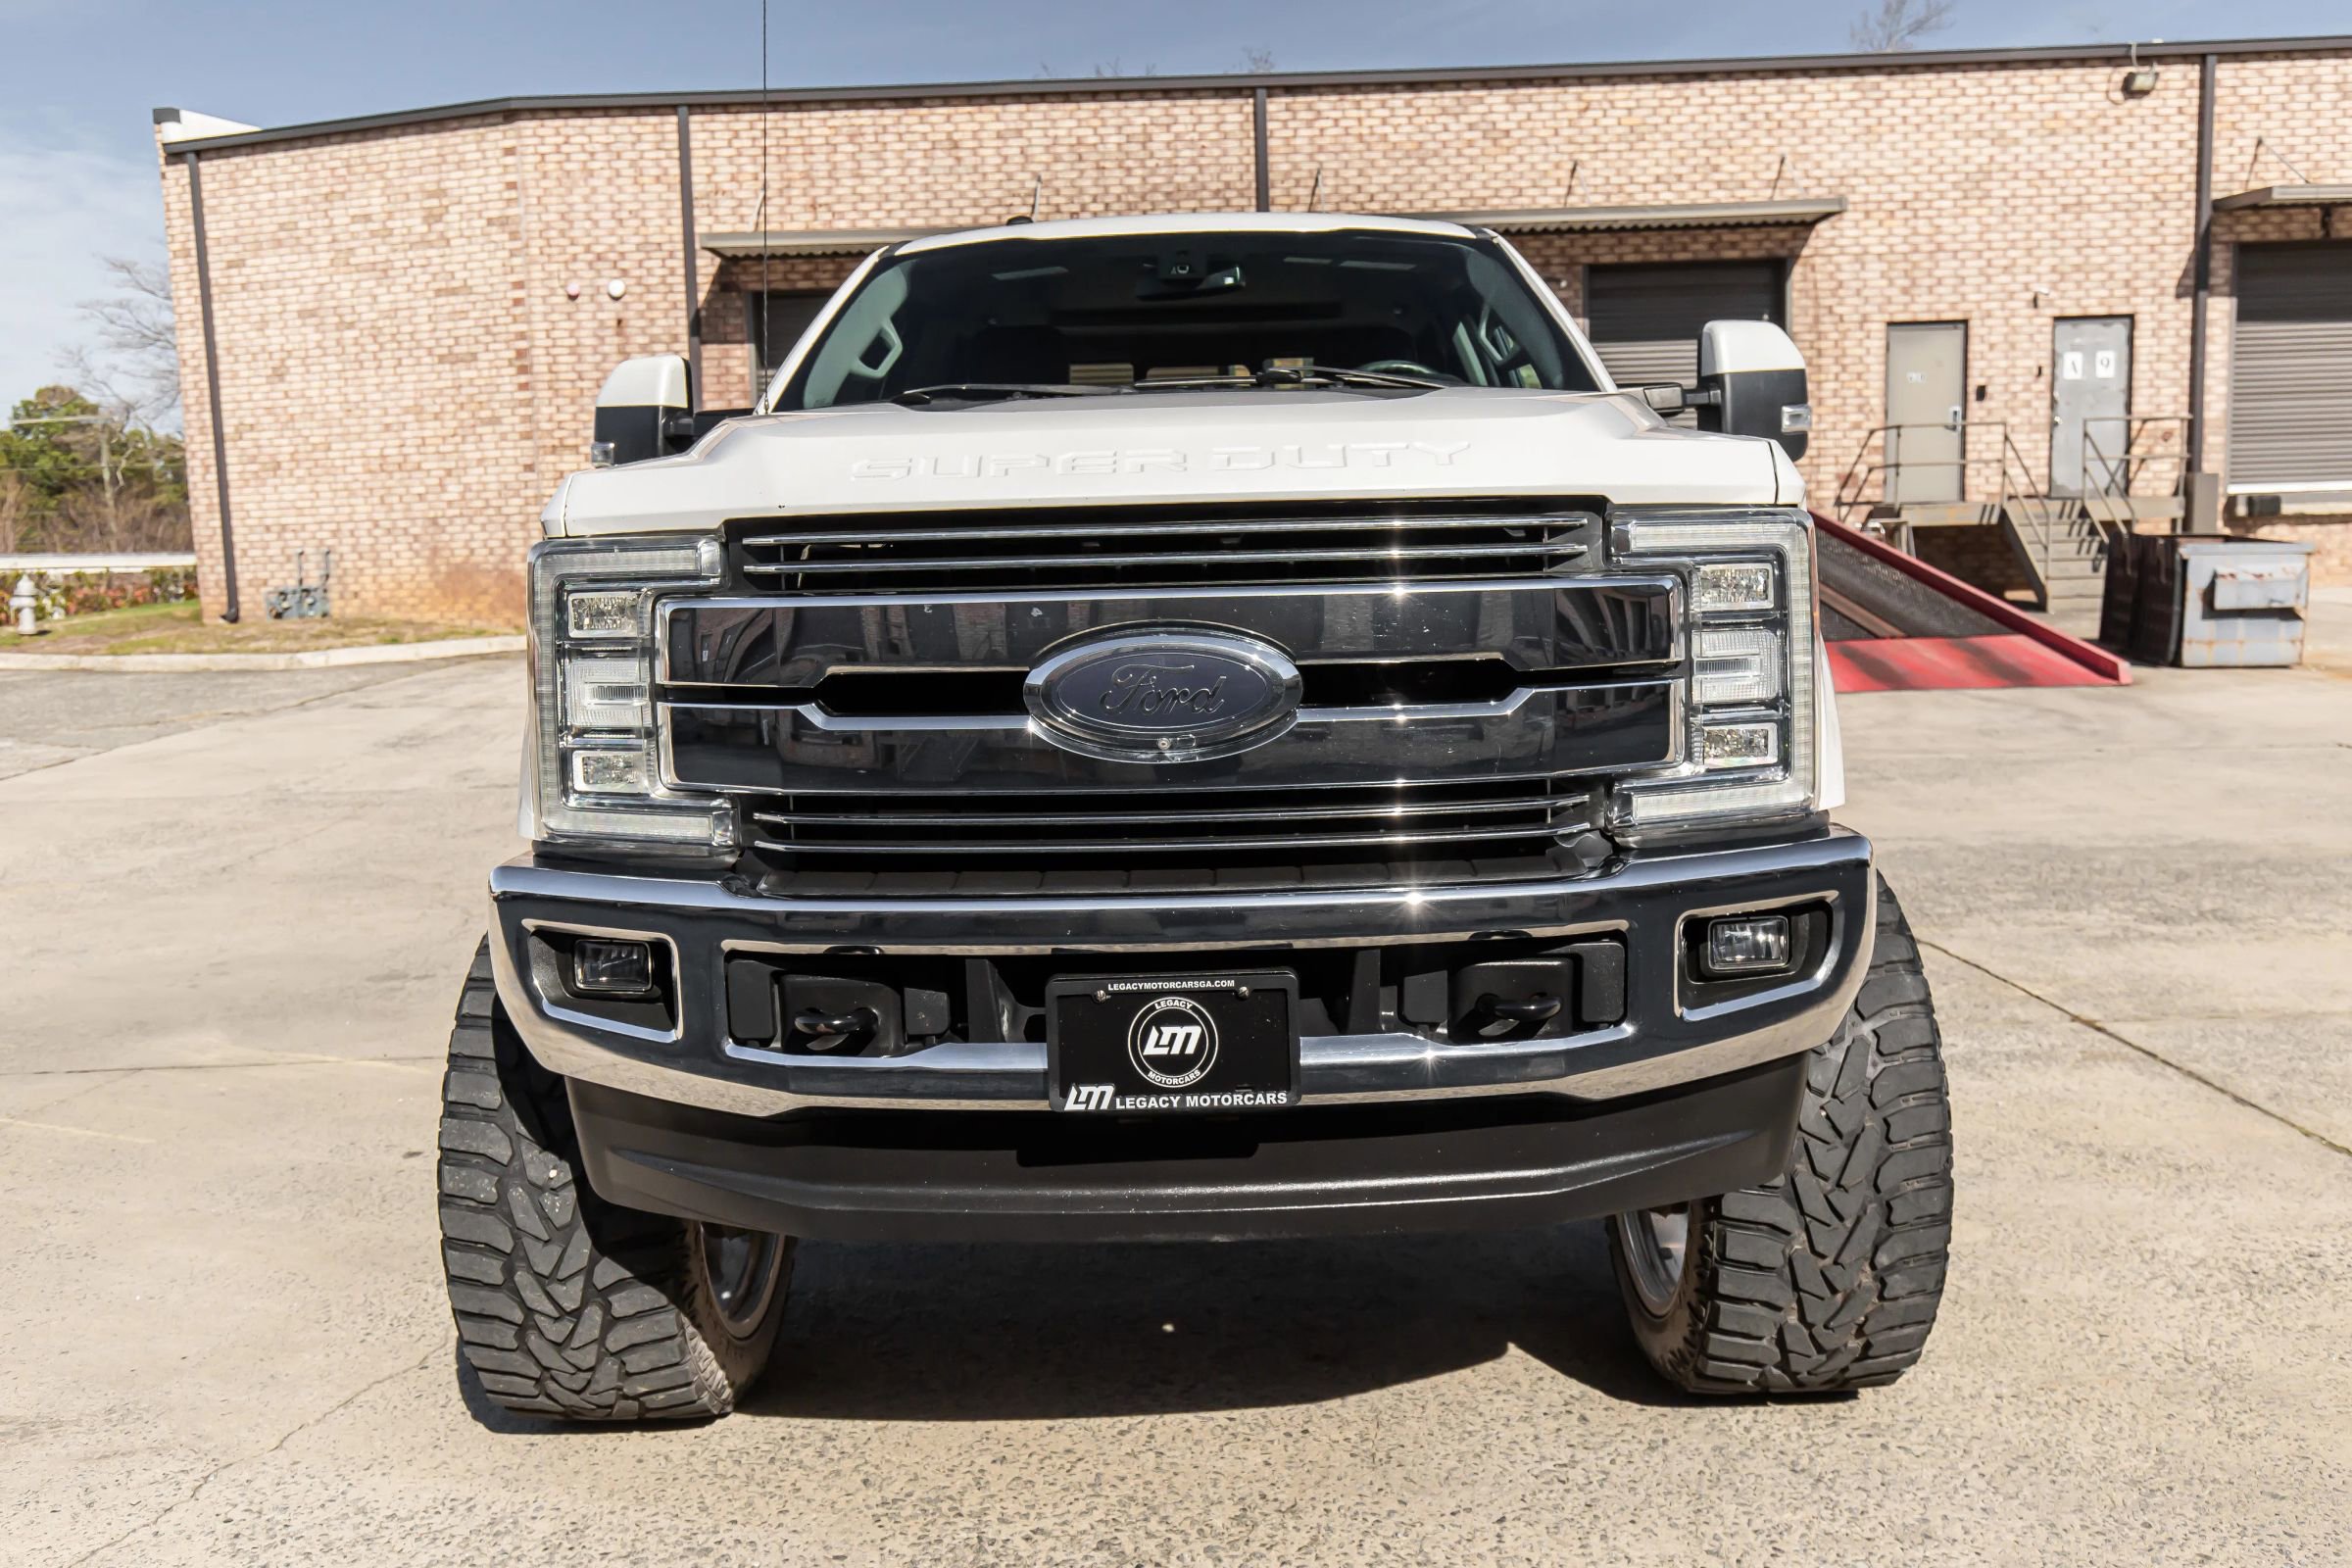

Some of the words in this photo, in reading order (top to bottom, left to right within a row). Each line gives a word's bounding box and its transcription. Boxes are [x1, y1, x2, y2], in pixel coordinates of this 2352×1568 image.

[850, 446, 1188, 481] SUPER
[1210, 440, 1471, 471] DUTY
[1099, 663, 1227, 715] Ford
[1107, 980, 1235, 991] LEGACYMOTORCARSGA.COM
[1154, 999, 1193, 1010] LEGACY
[1147, 1069, 1201, 1085] MOTORCARS
[1115, 1094, 1180, 1109] LEGACY
[1186, 1092, 1288, 1107] MOTORCARS
